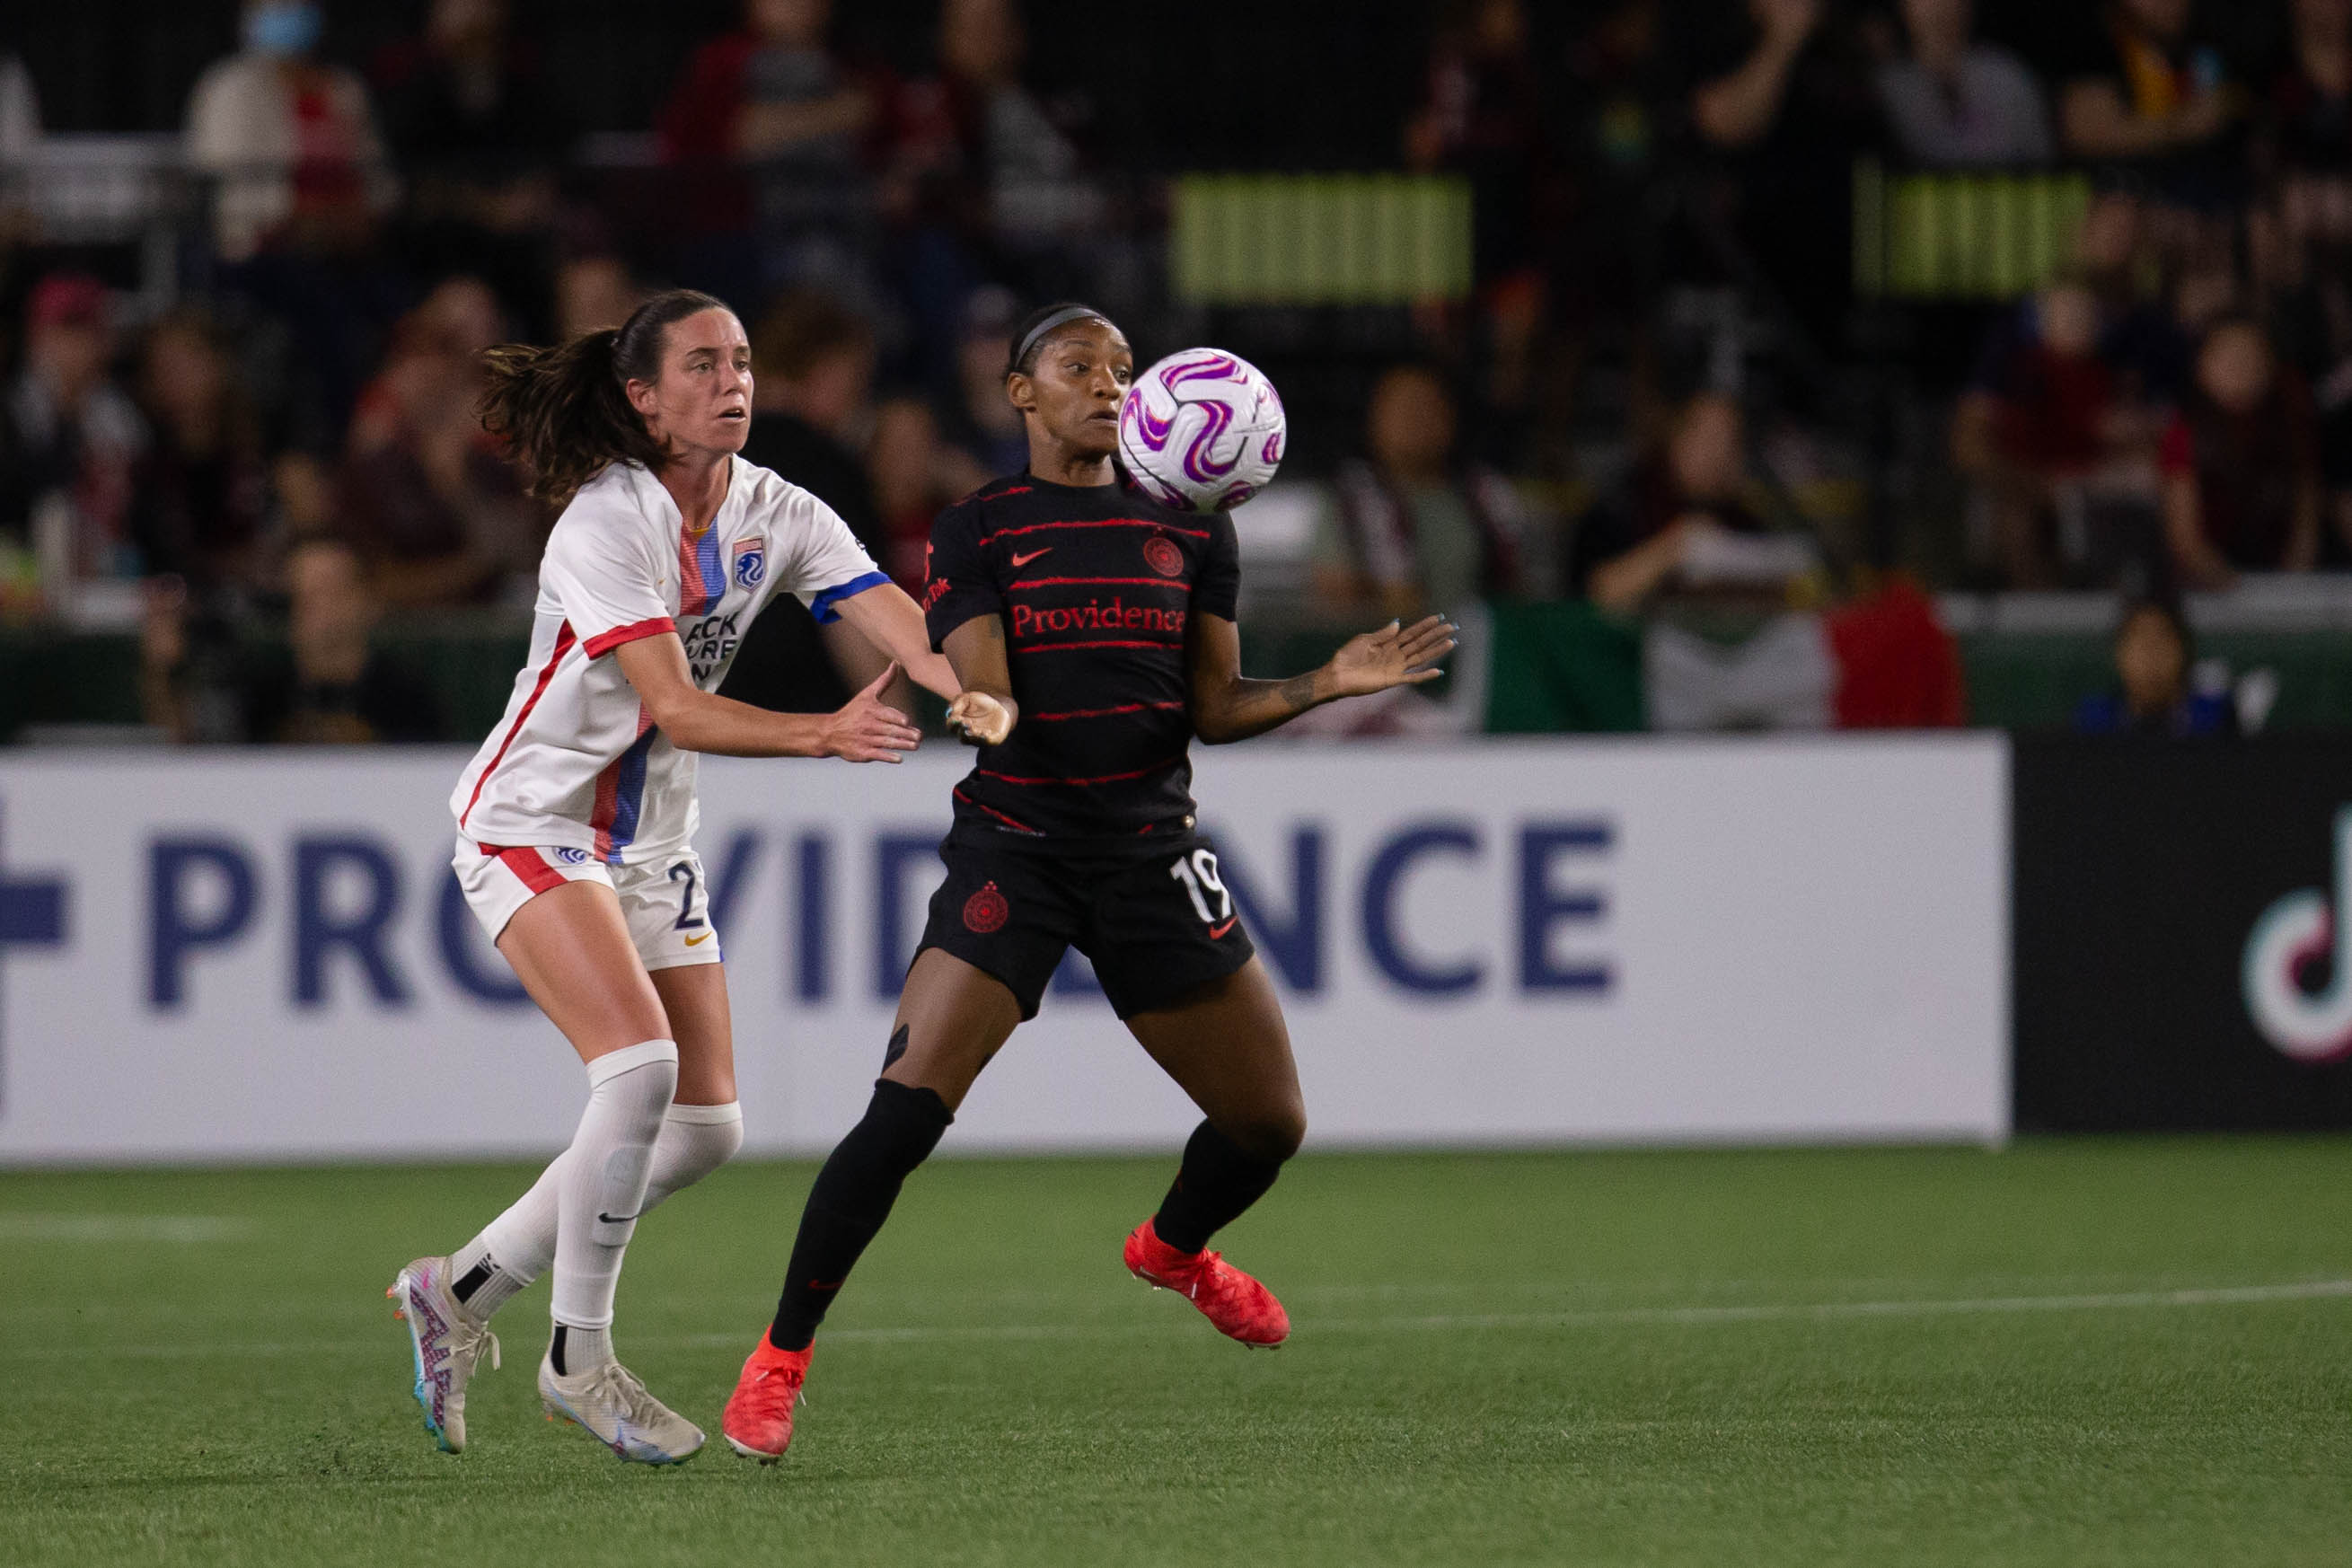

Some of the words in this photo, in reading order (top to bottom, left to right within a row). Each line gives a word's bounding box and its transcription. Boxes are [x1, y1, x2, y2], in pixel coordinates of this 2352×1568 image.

[683, 611, 741, 646] ACK
[1011, 596, 1186, 638] Providence
[148, 819, 1615, 1006] PRIDNCE
[668, 860, 705, 930] 2
[1169, 849, 1232, 924] 19
